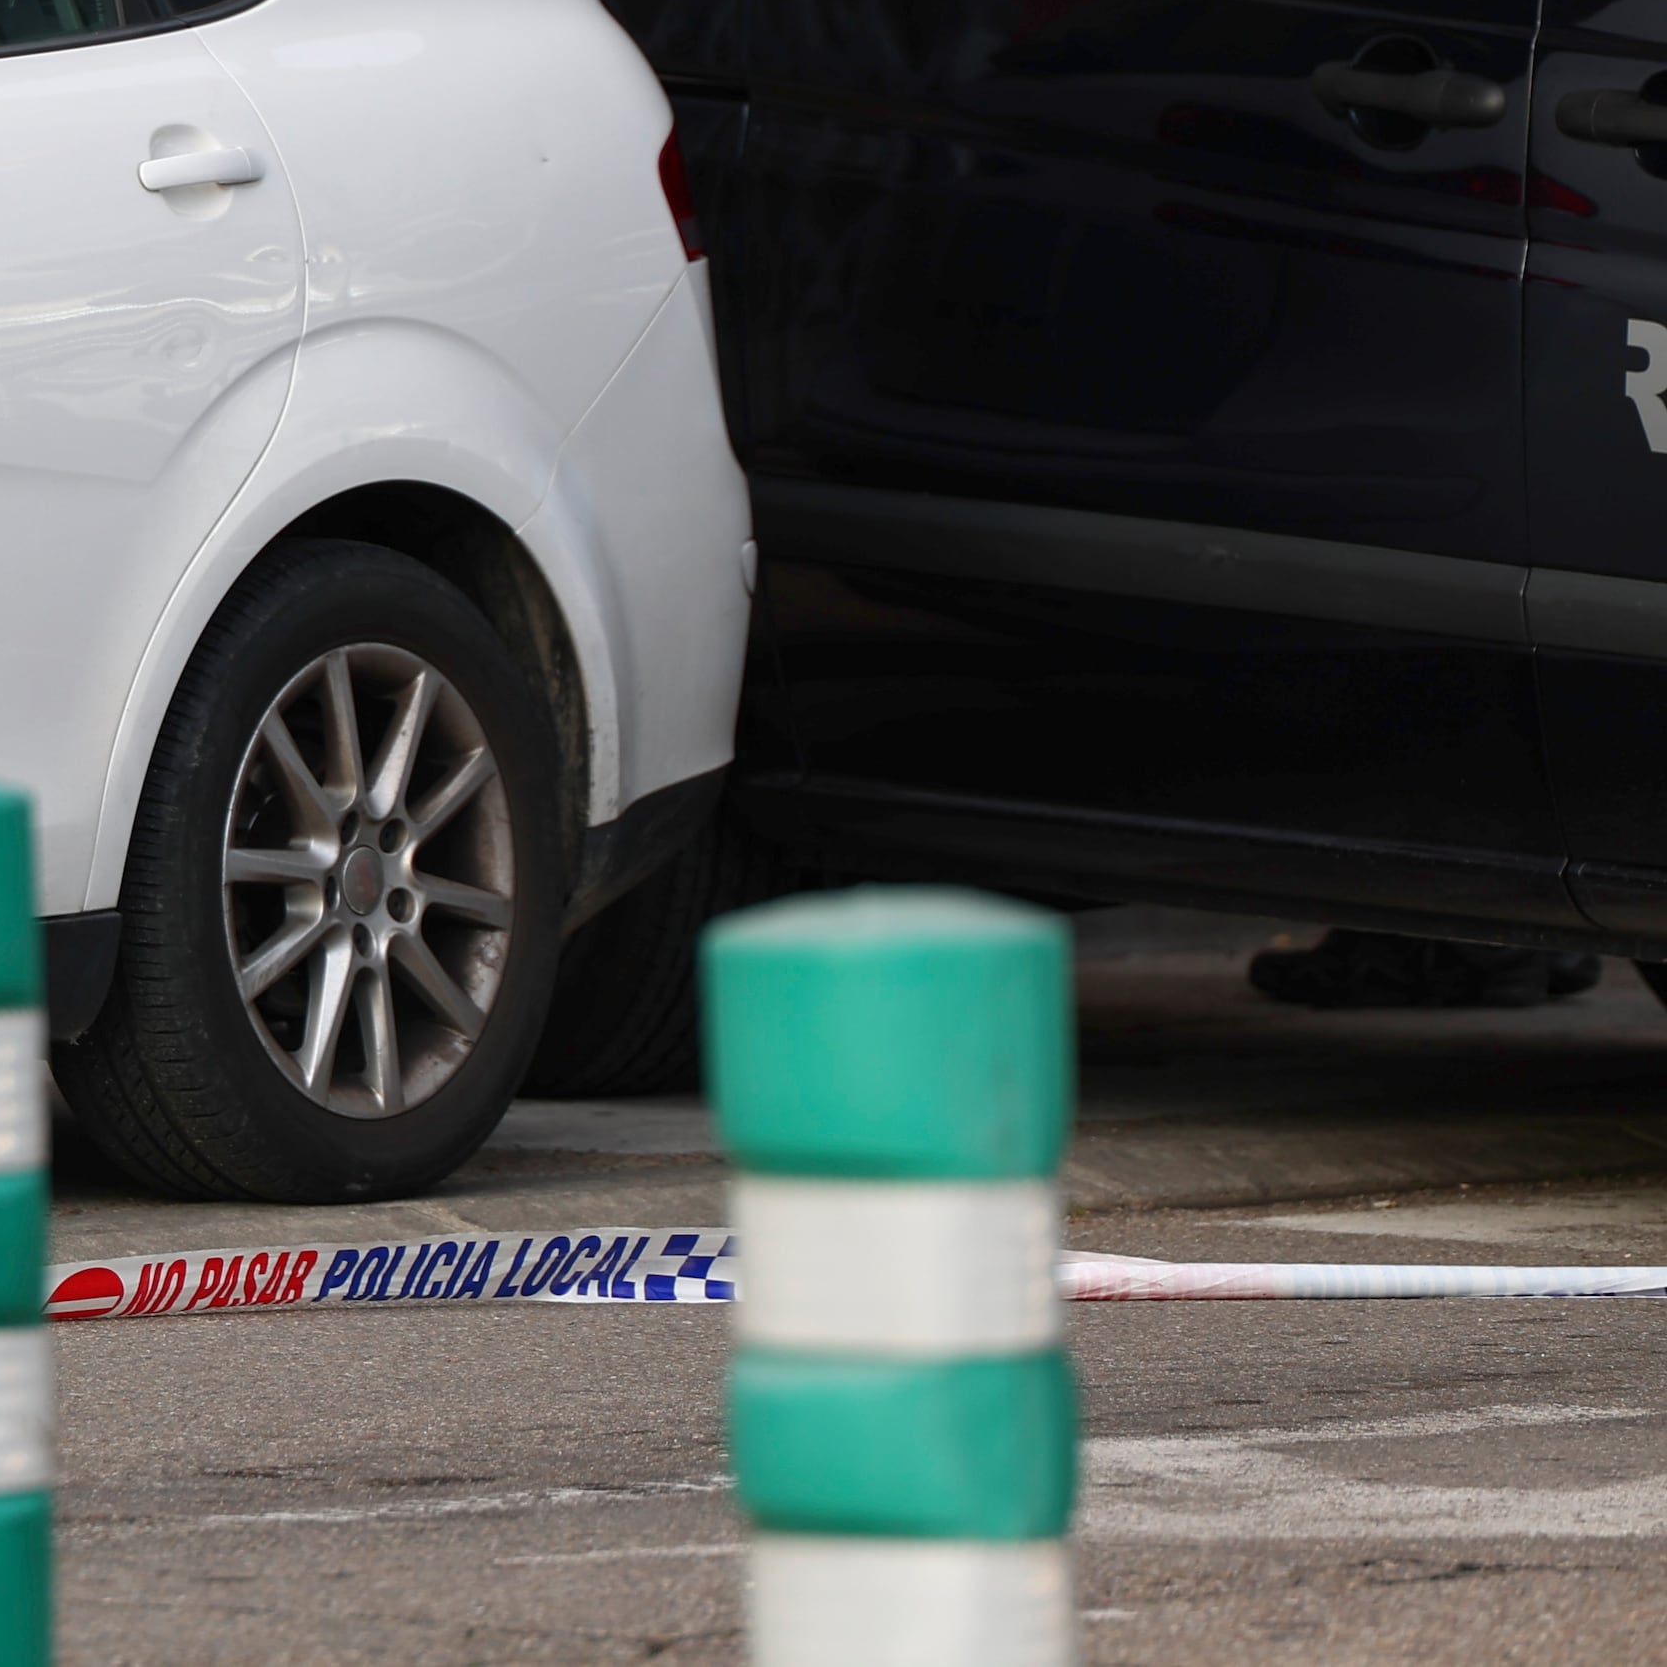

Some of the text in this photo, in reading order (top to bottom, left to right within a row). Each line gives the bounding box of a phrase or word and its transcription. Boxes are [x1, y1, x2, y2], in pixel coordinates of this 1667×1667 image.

[117, 1235, 651, 1316] NO PASAR POLICIA LOCAL
